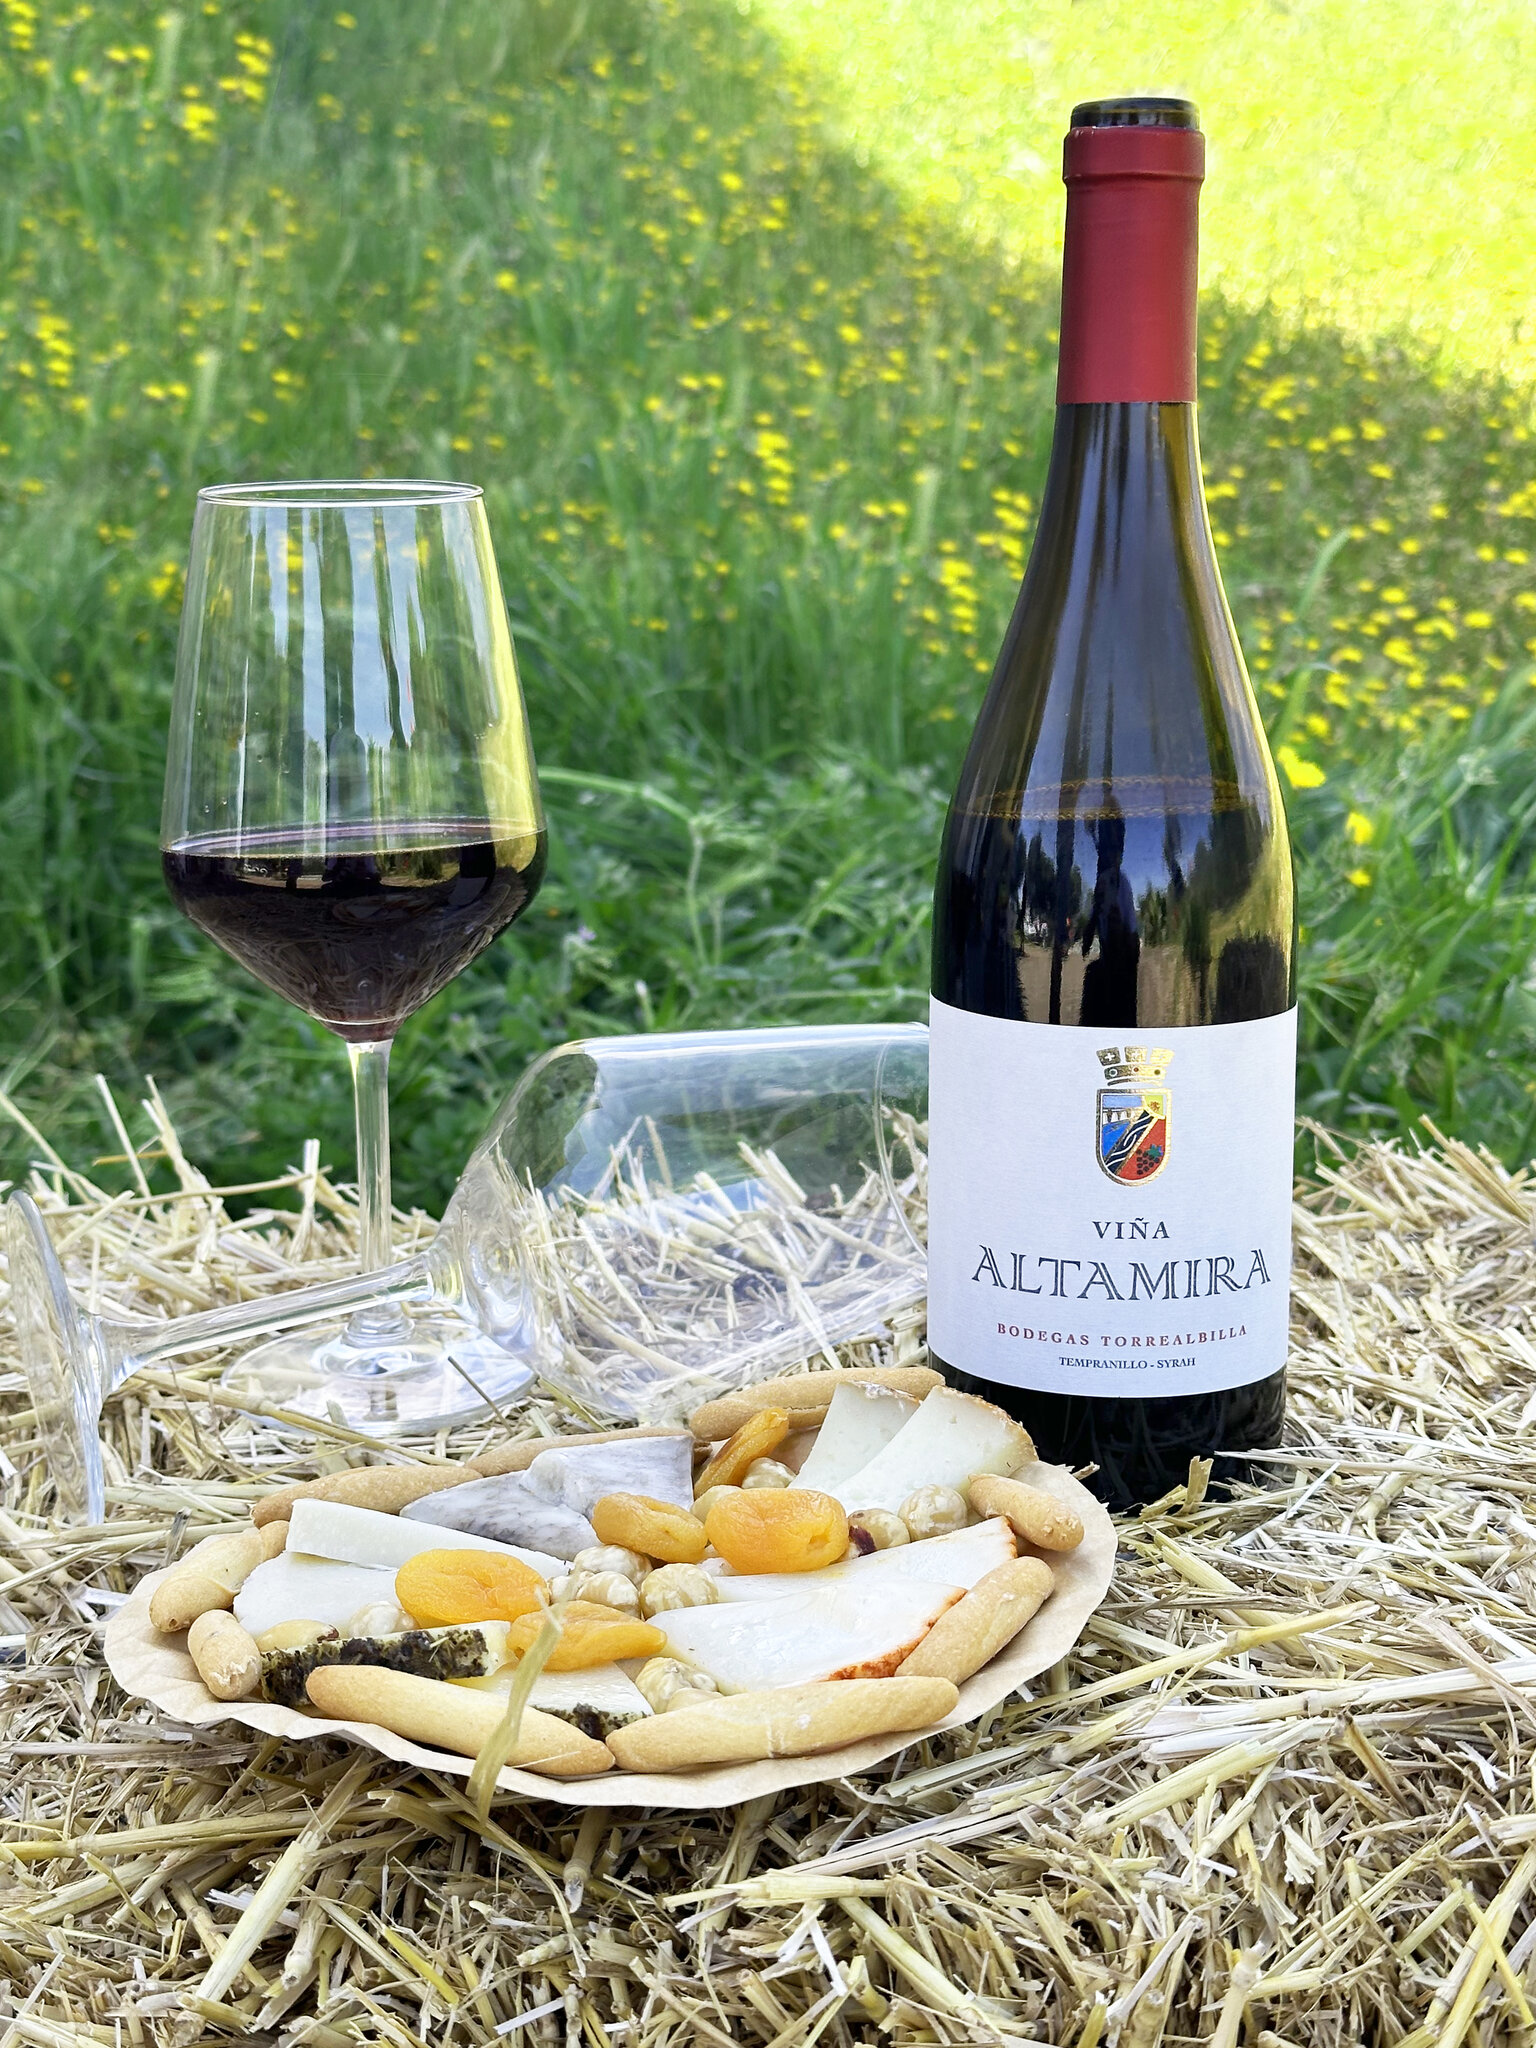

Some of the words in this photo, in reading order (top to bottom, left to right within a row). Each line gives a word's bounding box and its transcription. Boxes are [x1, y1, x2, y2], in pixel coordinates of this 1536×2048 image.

[1092, 1218, 1170, 1240] VIÑA
[971, 1244, 1271, 1300] ALTAMIRA
[997, 1323, 1089, 1345] BODEGAS
[1101, 1324, 1248, 1347] TORREALBILLA
[1059, 1356, 1148, 1369] TEMPRANILLO
[1156, 1356, 1196, 1369] SYRAH
